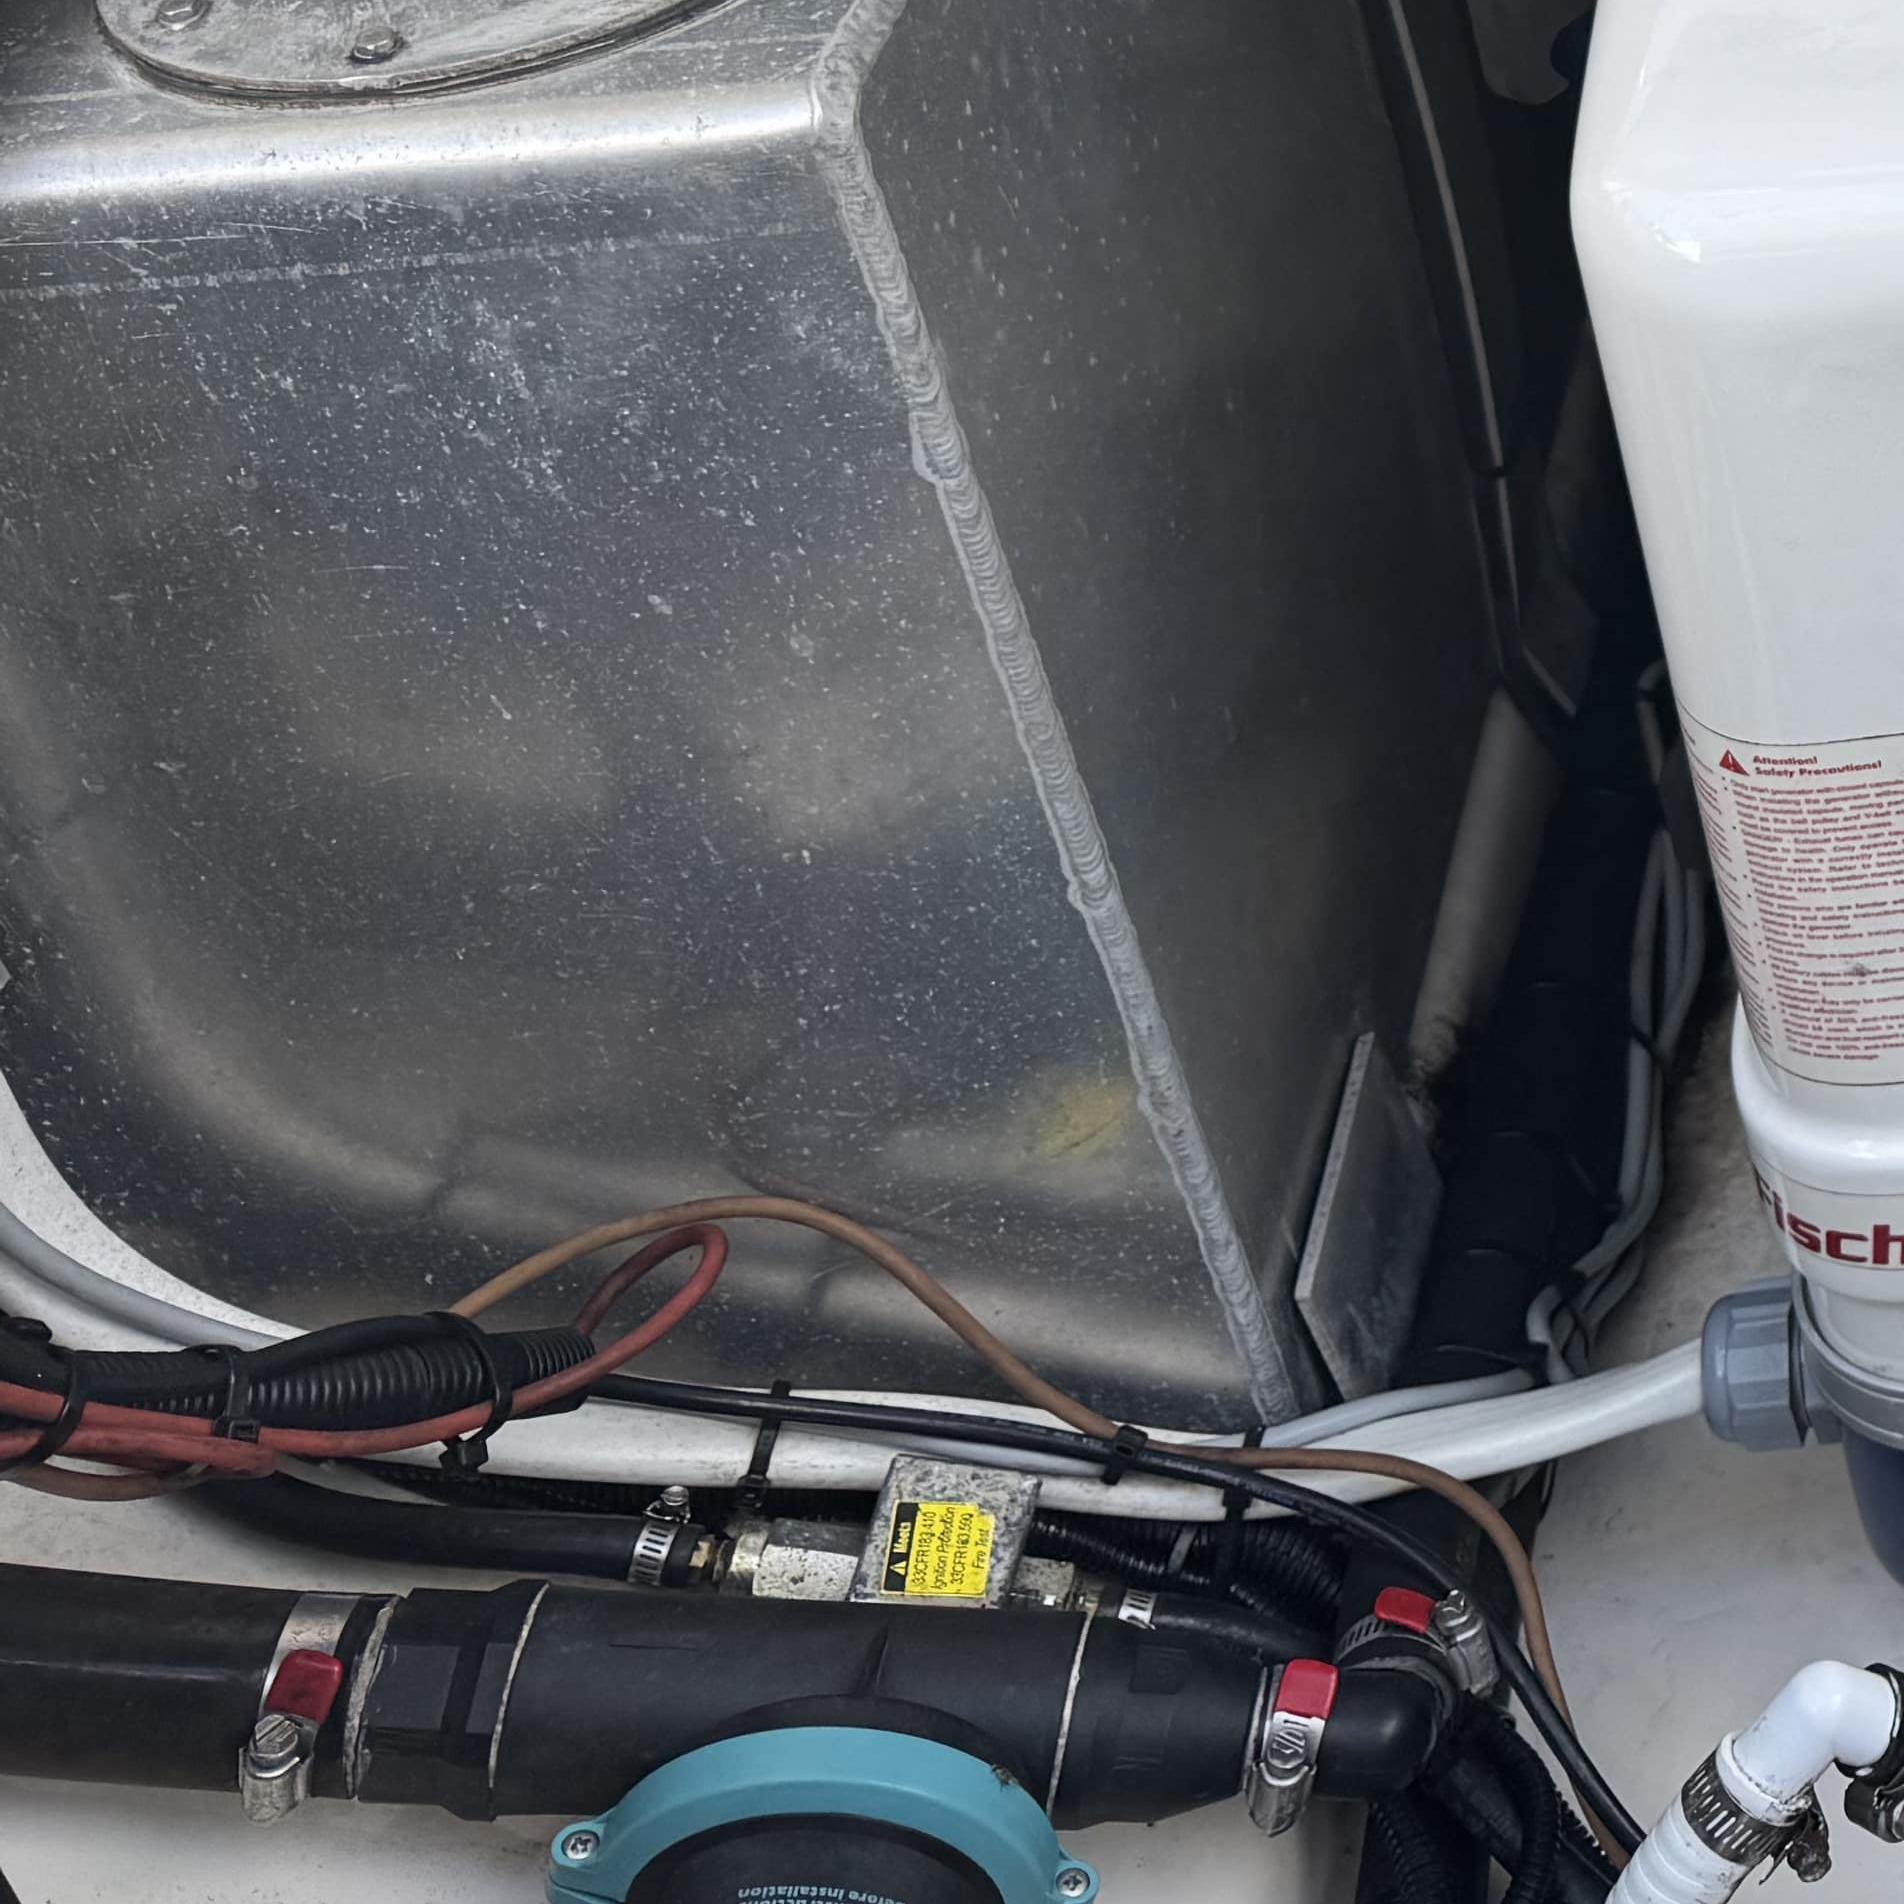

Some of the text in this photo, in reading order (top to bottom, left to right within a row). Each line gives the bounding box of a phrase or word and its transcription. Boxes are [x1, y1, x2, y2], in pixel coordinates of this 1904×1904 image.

[1752, 750, 1818, 770] Attention!
[1754, 759, 1882, 781] Safety Precautions!
